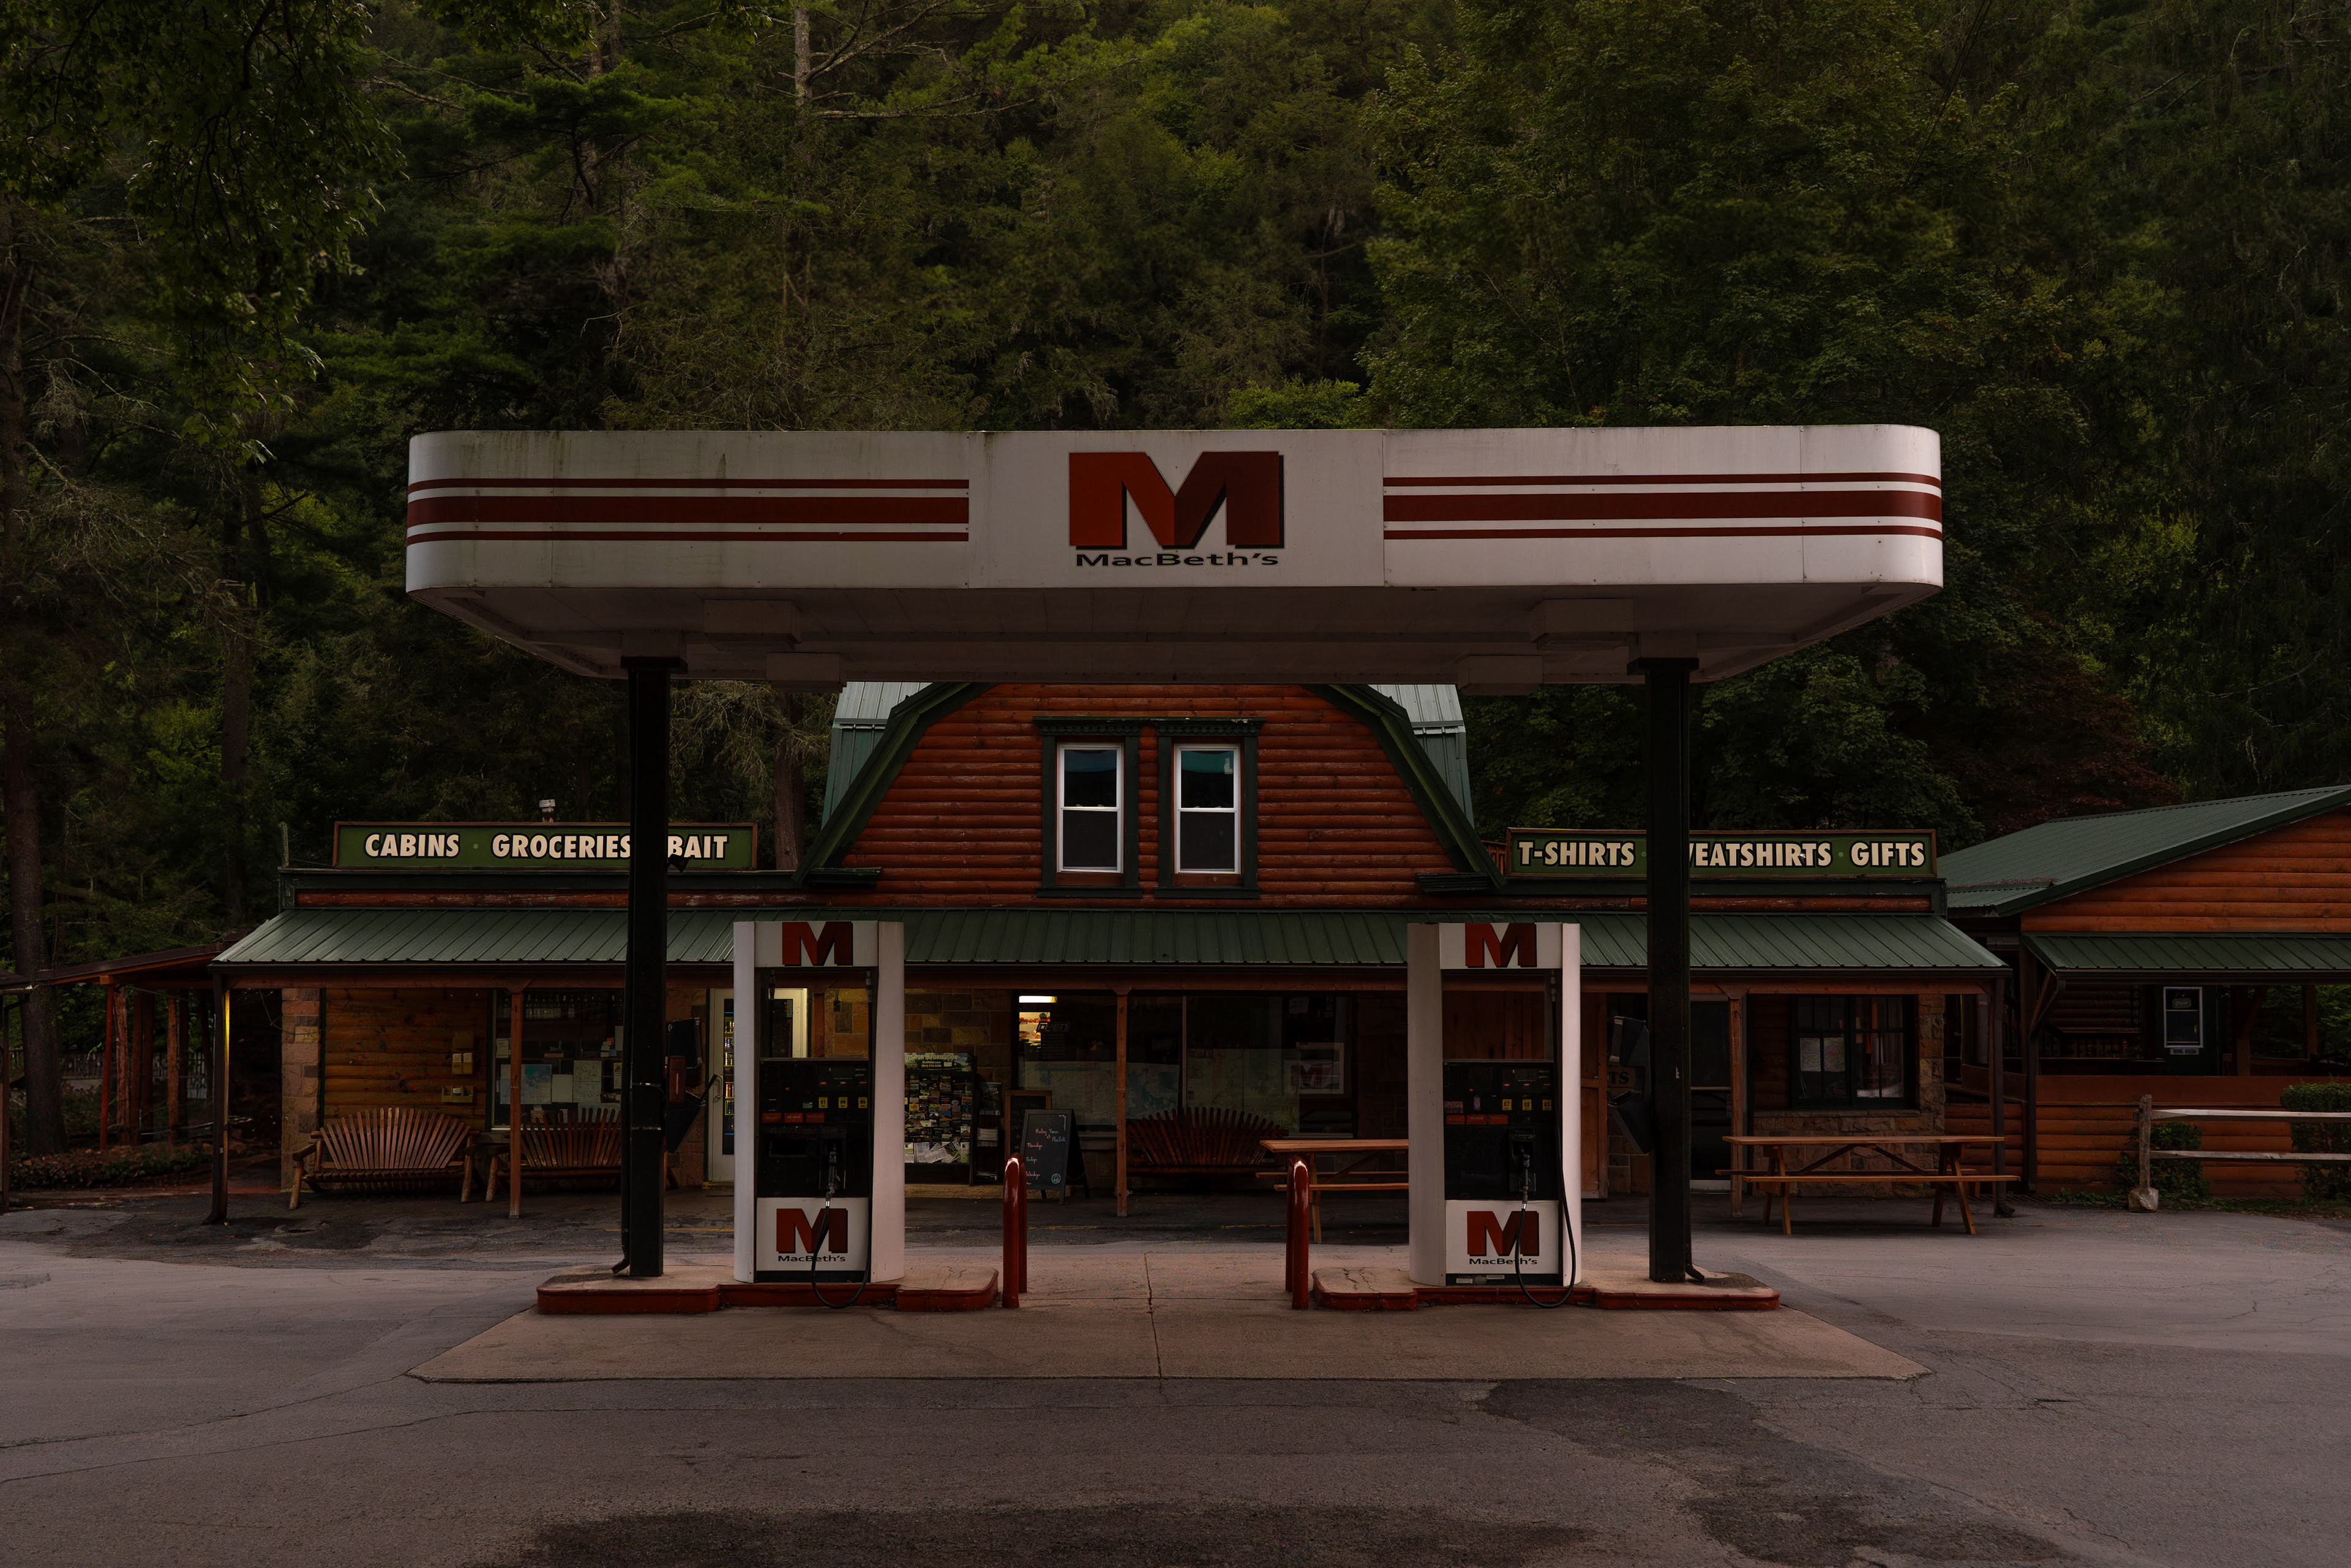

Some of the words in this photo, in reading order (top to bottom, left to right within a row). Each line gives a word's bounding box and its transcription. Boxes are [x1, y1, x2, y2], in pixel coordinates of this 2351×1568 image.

[1069, 452, 1284, 549] M
[1076, 553, 1279, 566] MacBeth's
[364, 833, 460, 858] CABINS
[492, 833, 631, 859] GROCERIES
[667, 835, 729, 859] BAIT
[1518, 841, 1636, 866] T-SHIRTS
[1689, 841, 1832, 868] EATSHIRTS
[1851, 841, 1925, 867] GIFTS
[782, 921, 853, 966] M
[1465, 923, 1537, 967] M
[776, 1209, 848, 1253] M
[1467, 1211, 1539, 1256] M
